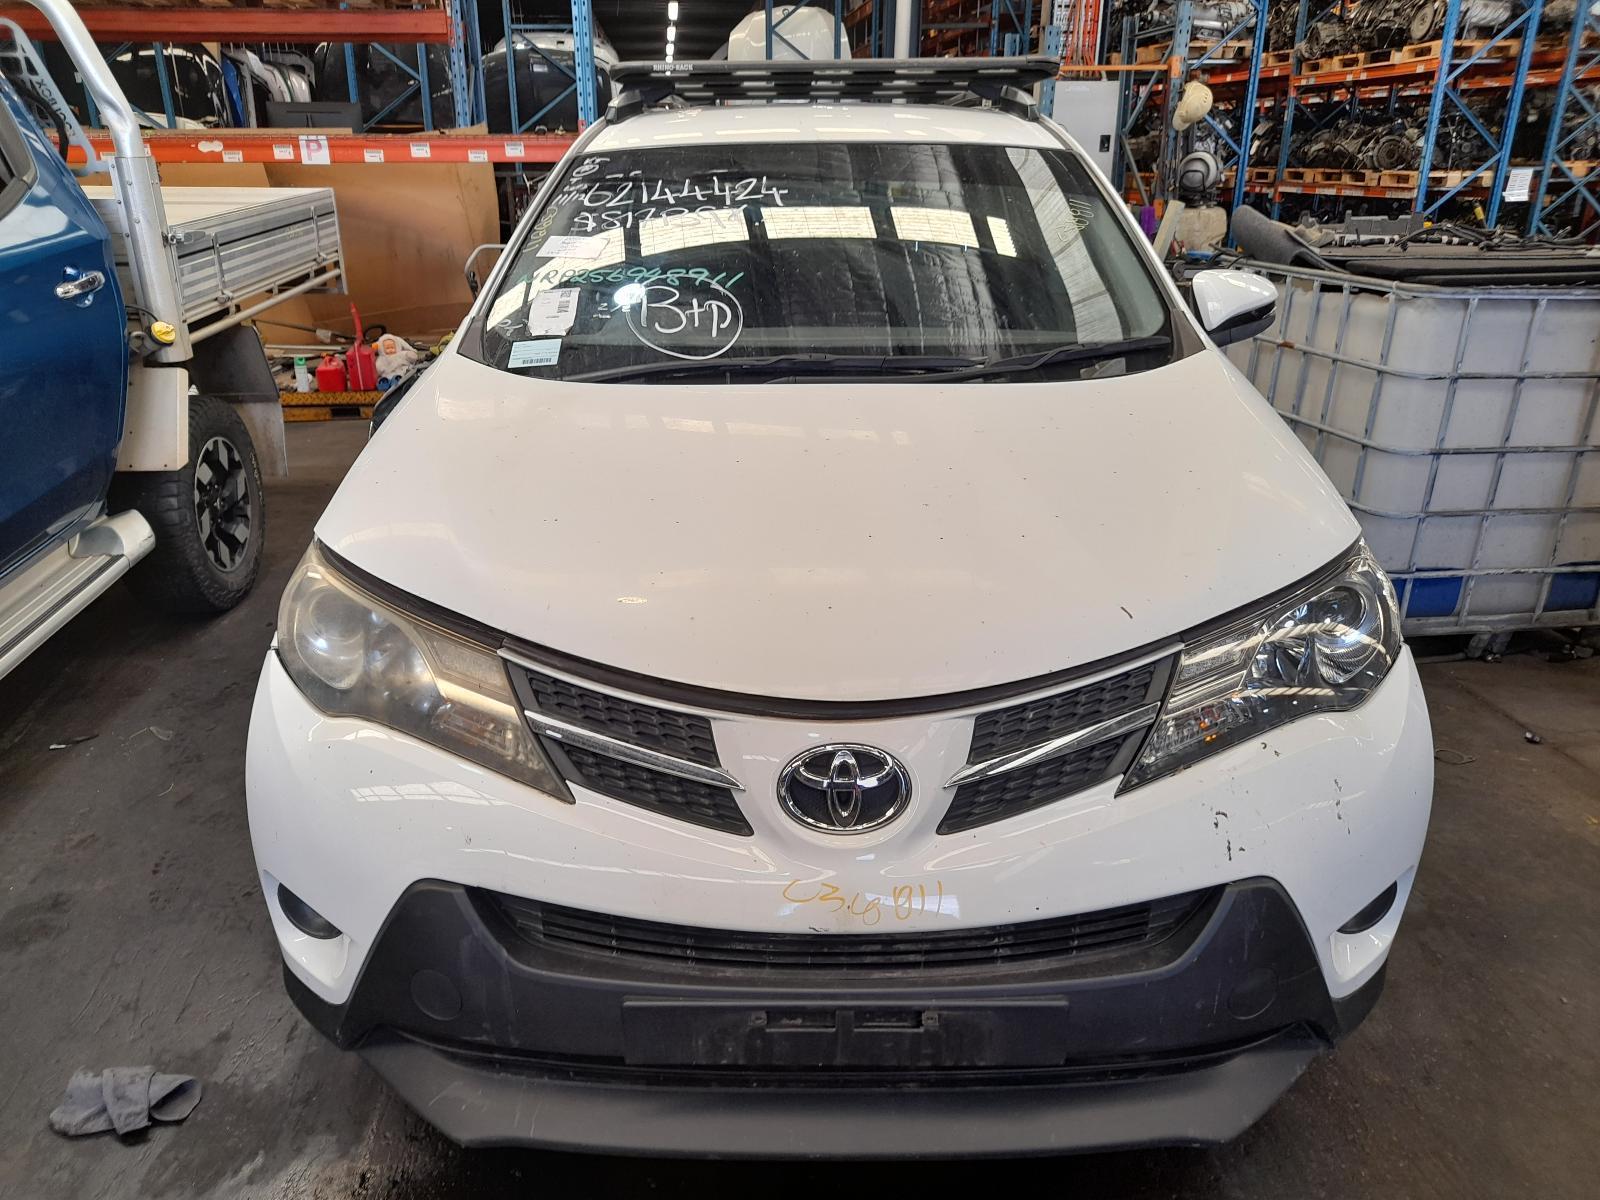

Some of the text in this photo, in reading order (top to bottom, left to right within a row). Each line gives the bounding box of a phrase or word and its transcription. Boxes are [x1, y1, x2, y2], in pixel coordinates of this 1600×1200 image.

[652, 63, 694, 72] RHINO-RACK
[305, 140, 323, 161] P
[584, 175, 789, 207] 62144424
